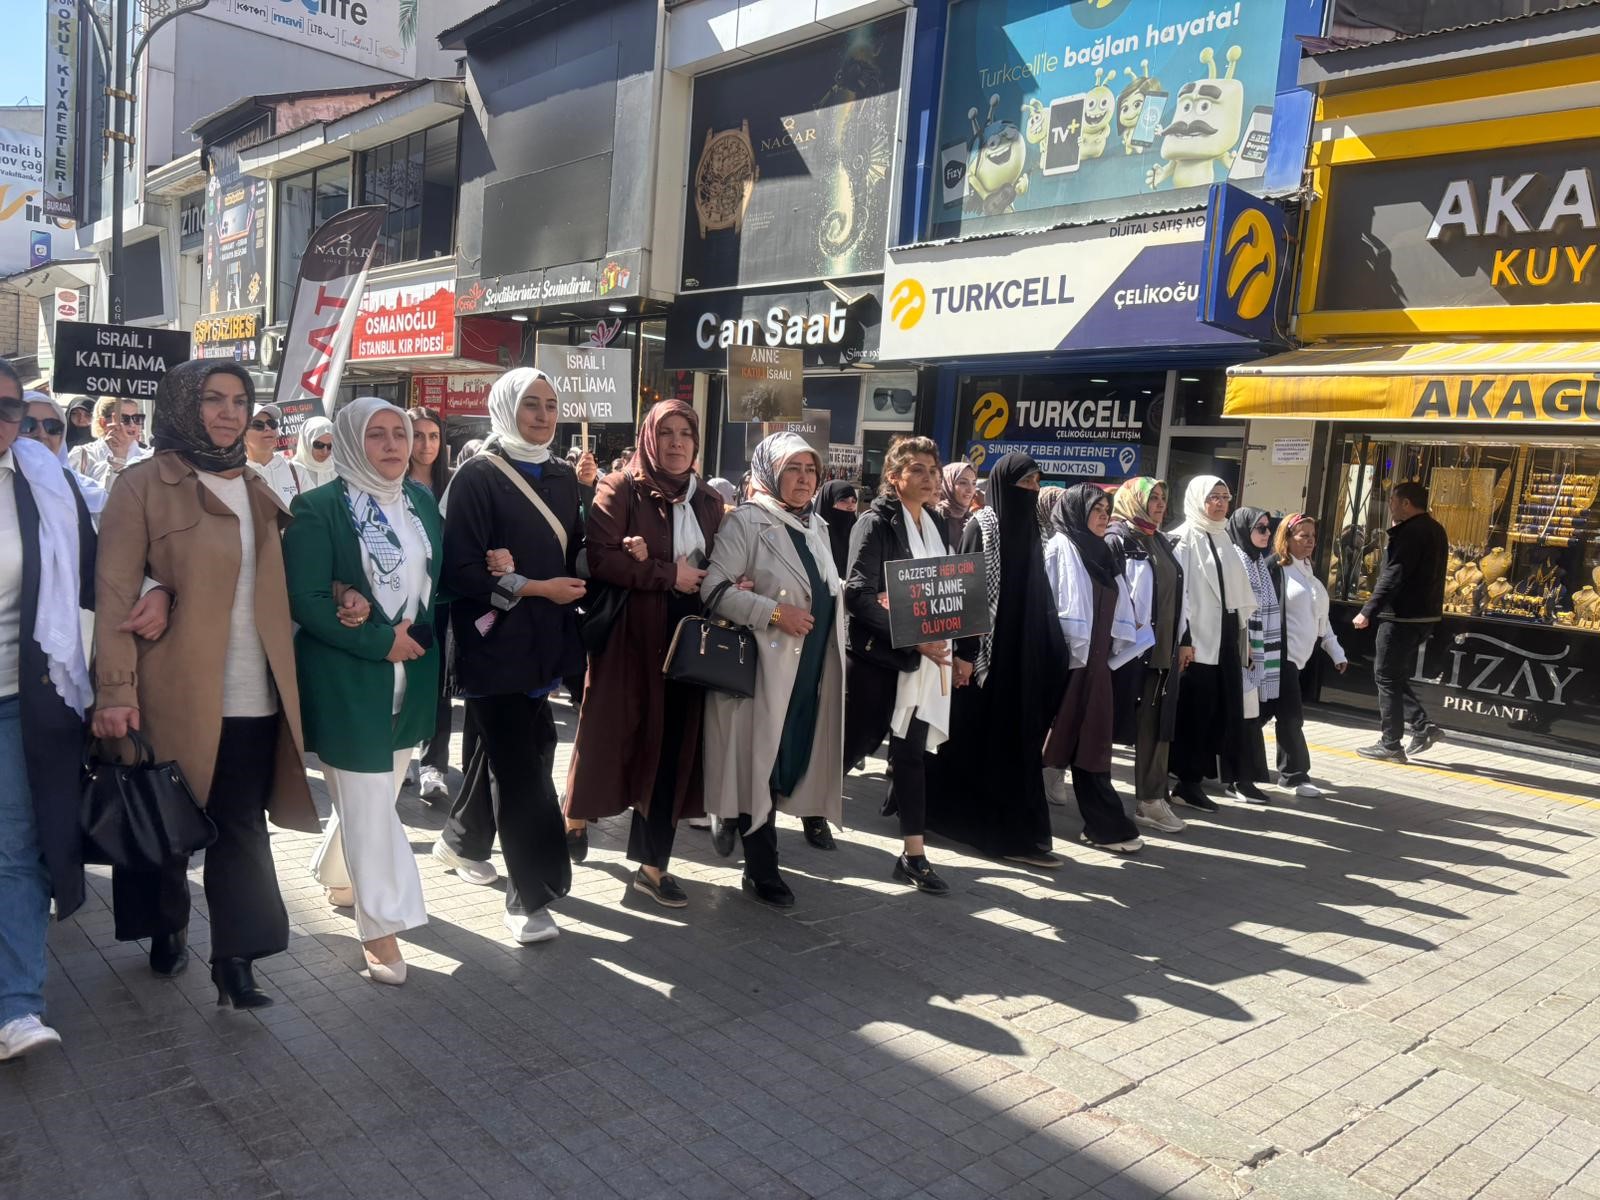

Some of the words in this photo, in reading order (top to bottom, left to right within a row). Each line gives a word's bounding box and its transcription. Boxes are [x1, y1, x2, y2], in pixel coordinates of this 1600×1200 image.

[273, 13, 303, 29] mavi
[311, 24, 323, 35] LTB
[58, 9, 71, 56] OKUL
[980, 53, 1058, 89] Turkcell'le
[1064, 33, 1139, 68] bağlan
[1145, 3, 1240, 49] hayata!
[761, 128, 817, 152] NACAR
[46, 200, 71, 213] BURADA
[1426, 167, 1599, 240] AKA
[1110, 222, 1148, 237] DİJİTAL
[1152, 217, 1183, 232] SATIŞ
[1186, 215, 1206, 228] NO
[314, 244, 371, 258] NACAR
[1491, 243, 1598, 286] KUY
[932, 275, 1074, 314] TURKCELL
[1114, 281, 1199, 309] ÇELİKOĞU
[366, 308, 436, 334] OSMANOĞLU
[696, 312, 753, 349] Can
[765, 301, 847, 347] Saat
[97, 328, 144, 348] İSRAİL
[359, 338, 396, 356] İSTANBUL
[399, 336, 413, 353] KIR
[415, 332, 444, 351] PİDESİ
[76, 350, 167, 372] KATLİAMA
[567, 352, 600, 369] İSRAİL
[751, 348, 780, 364] ANNE
[766, 366, 792, 380] İSRAİL!
[86, 377, 121, 393] SON
[126, 379, 158, 395] VER
[553, 374, 616, 393] KATLİAMA
[562, 403, 587, 418] SON
[590, 402, 613, 417] VER
[1016, 400, 1142, 428] TURKCELL
[1056, 429, 1109, 440] ÇELİKOĞULLARI
[1111, 430, 1141, 441] İLETİŞİM
[1052, 462, 1098, 474] NOKTASI
[898, 566, 937, 581] GAZZE'DE
[939, 564, 956, 577] HER
[909, 580, 935, 599] 37'Sİ
[937, 579, 966, 595] ANNE,
[913, 601, 928, 617] 63
[930, 596, 963, 615] KADIN
[921, 617, 962, 635] ÖLÜYOR!
[1443, 696, 1538, 722] PIRLANT
